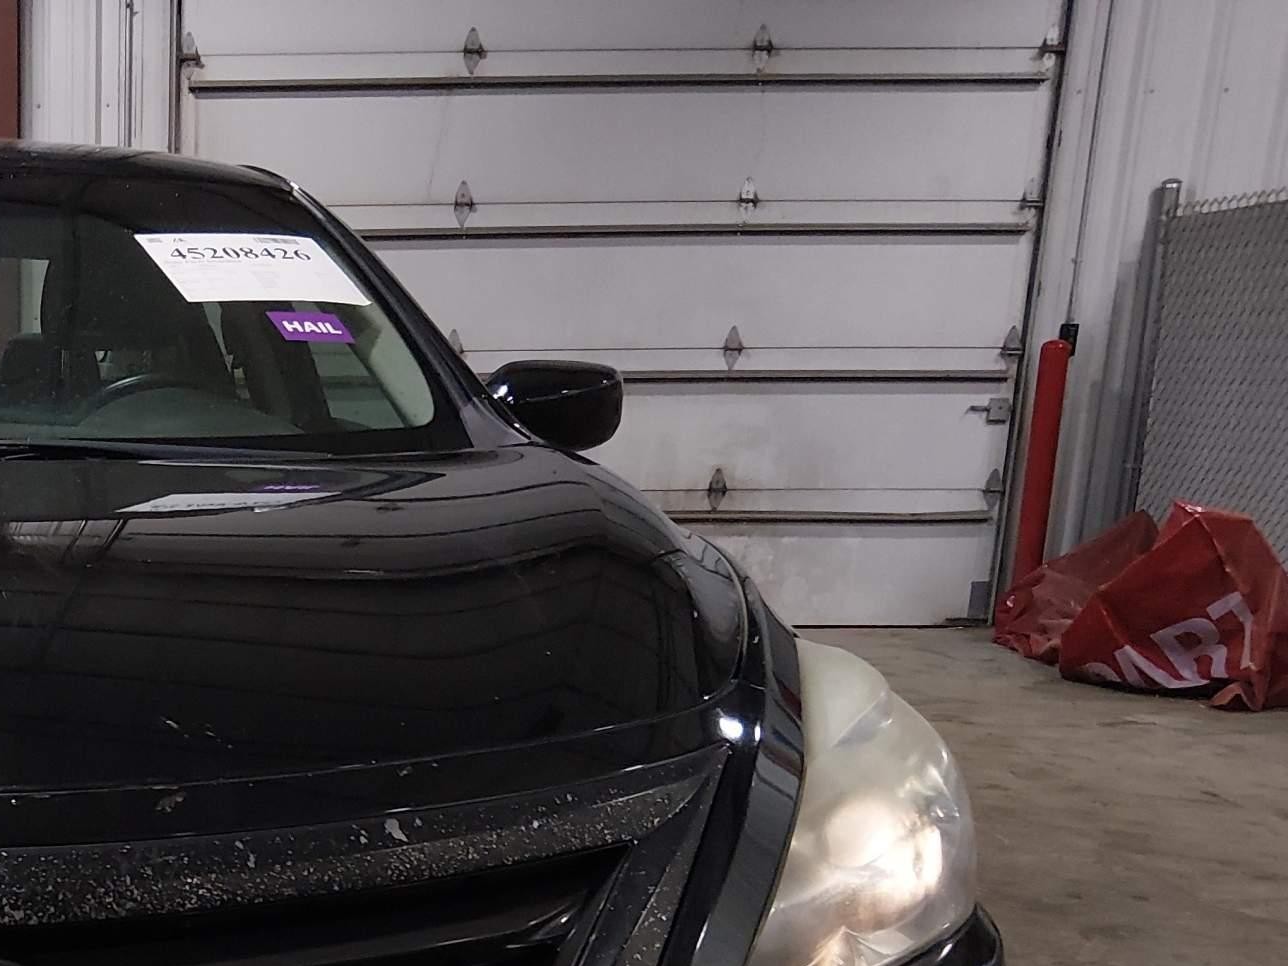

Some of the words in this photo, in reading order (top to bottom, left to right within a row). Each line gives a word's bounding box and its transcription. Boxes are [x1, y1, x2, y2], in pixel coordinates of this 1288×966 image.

[170, 247, 312, 262] 45208426
[281, 320, 343, 335] HAIL
[1084, 591, 1255, 688] ART
